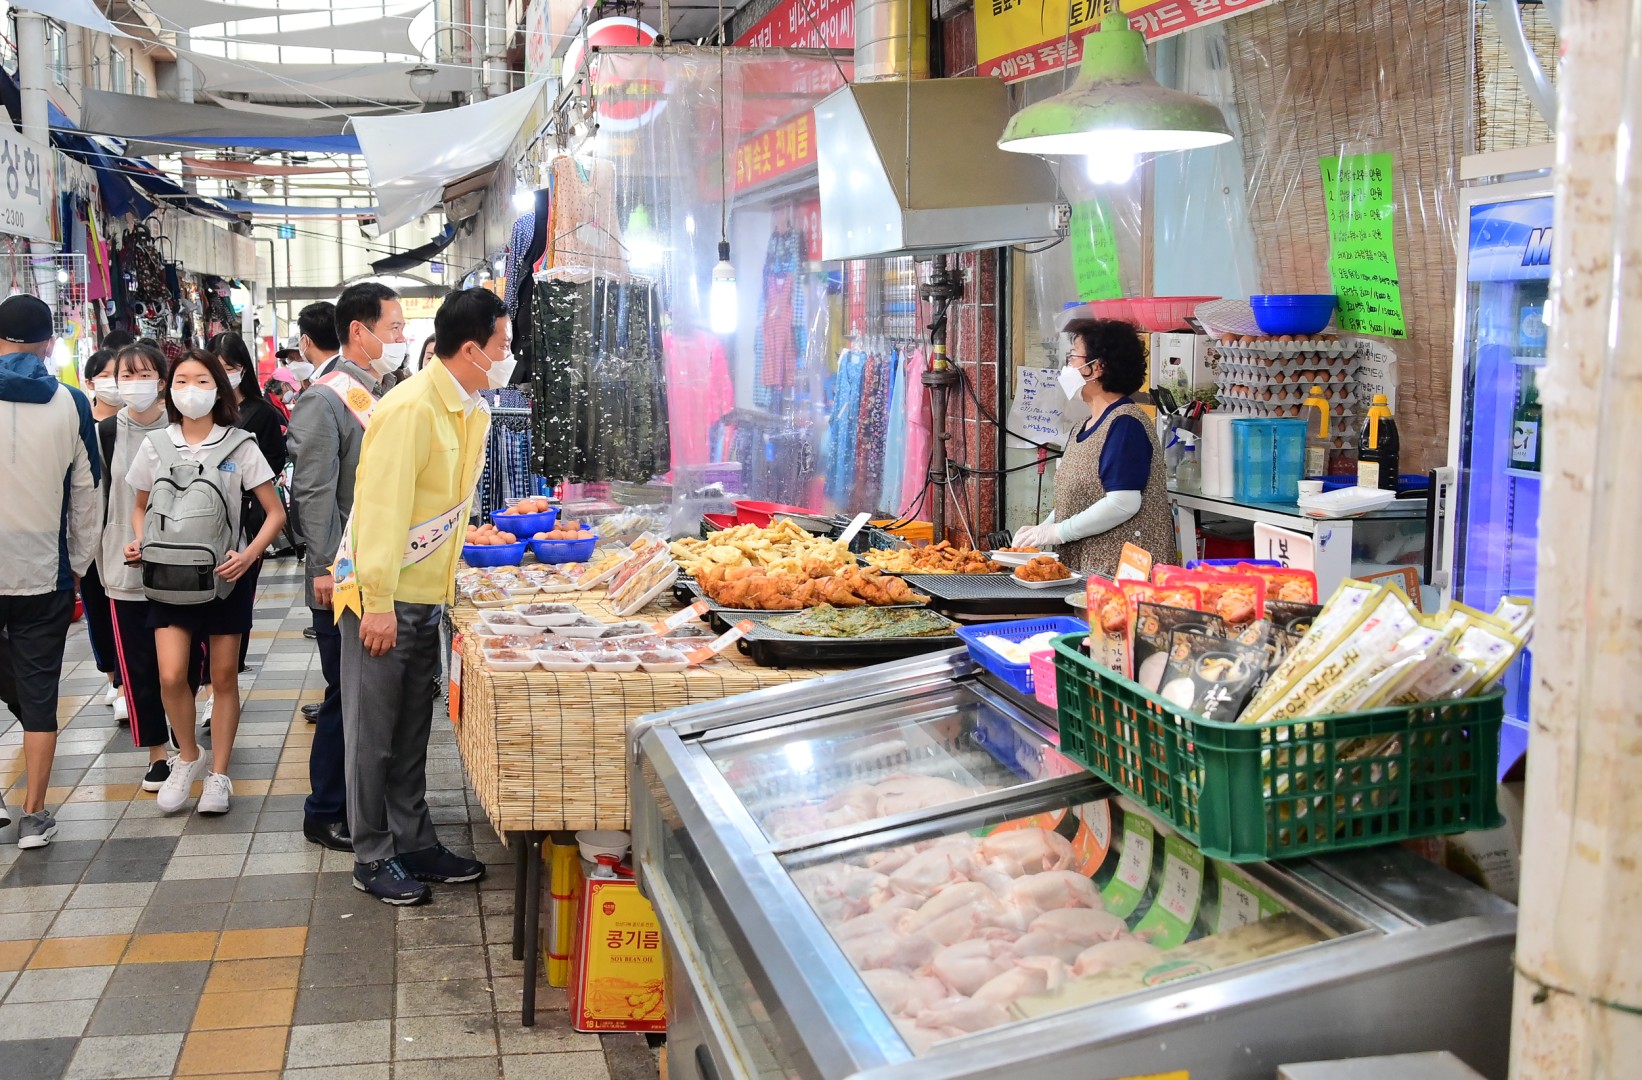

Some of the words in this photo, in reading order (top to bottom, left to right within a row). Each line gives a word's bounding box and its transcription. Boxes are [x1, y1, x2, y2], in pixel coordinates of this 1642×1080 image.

[1130, 3, 1186, 32] 카드
[1193, 0, 1247, 17] 환
[1000, 52, 1036, 77] 예약
[1038, 40, 1079, 66] 주문
[1, 139, 41, 205] 상회
[1, 208, 24, 228] -2300
[606, 930, 660, 949] 콩기름
